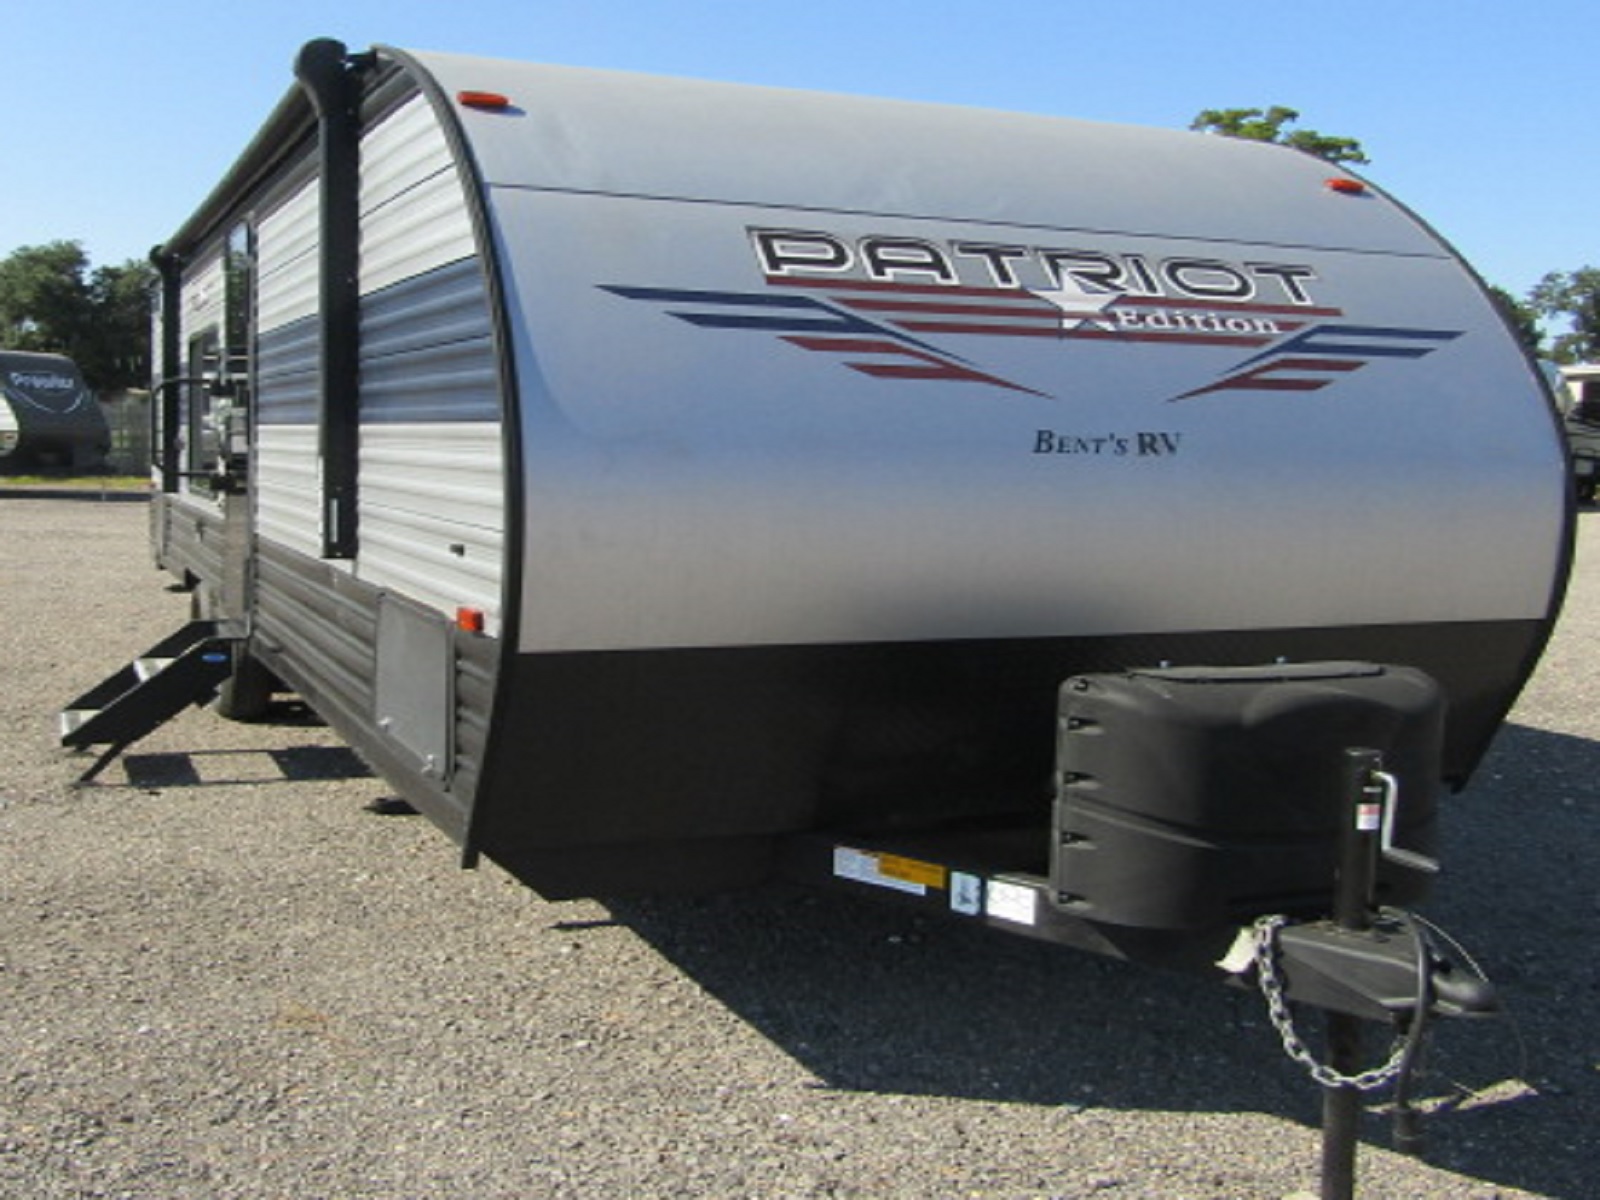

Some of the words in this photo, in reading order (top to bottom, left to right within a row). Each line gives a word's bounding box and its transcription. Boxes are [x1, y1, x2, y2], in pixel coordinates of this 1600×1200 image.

[748, 227, 1319, 306] PATRIOT
[1115, 309, 1280, 335] Edition
[1137, 432, 1180, 456] RV
